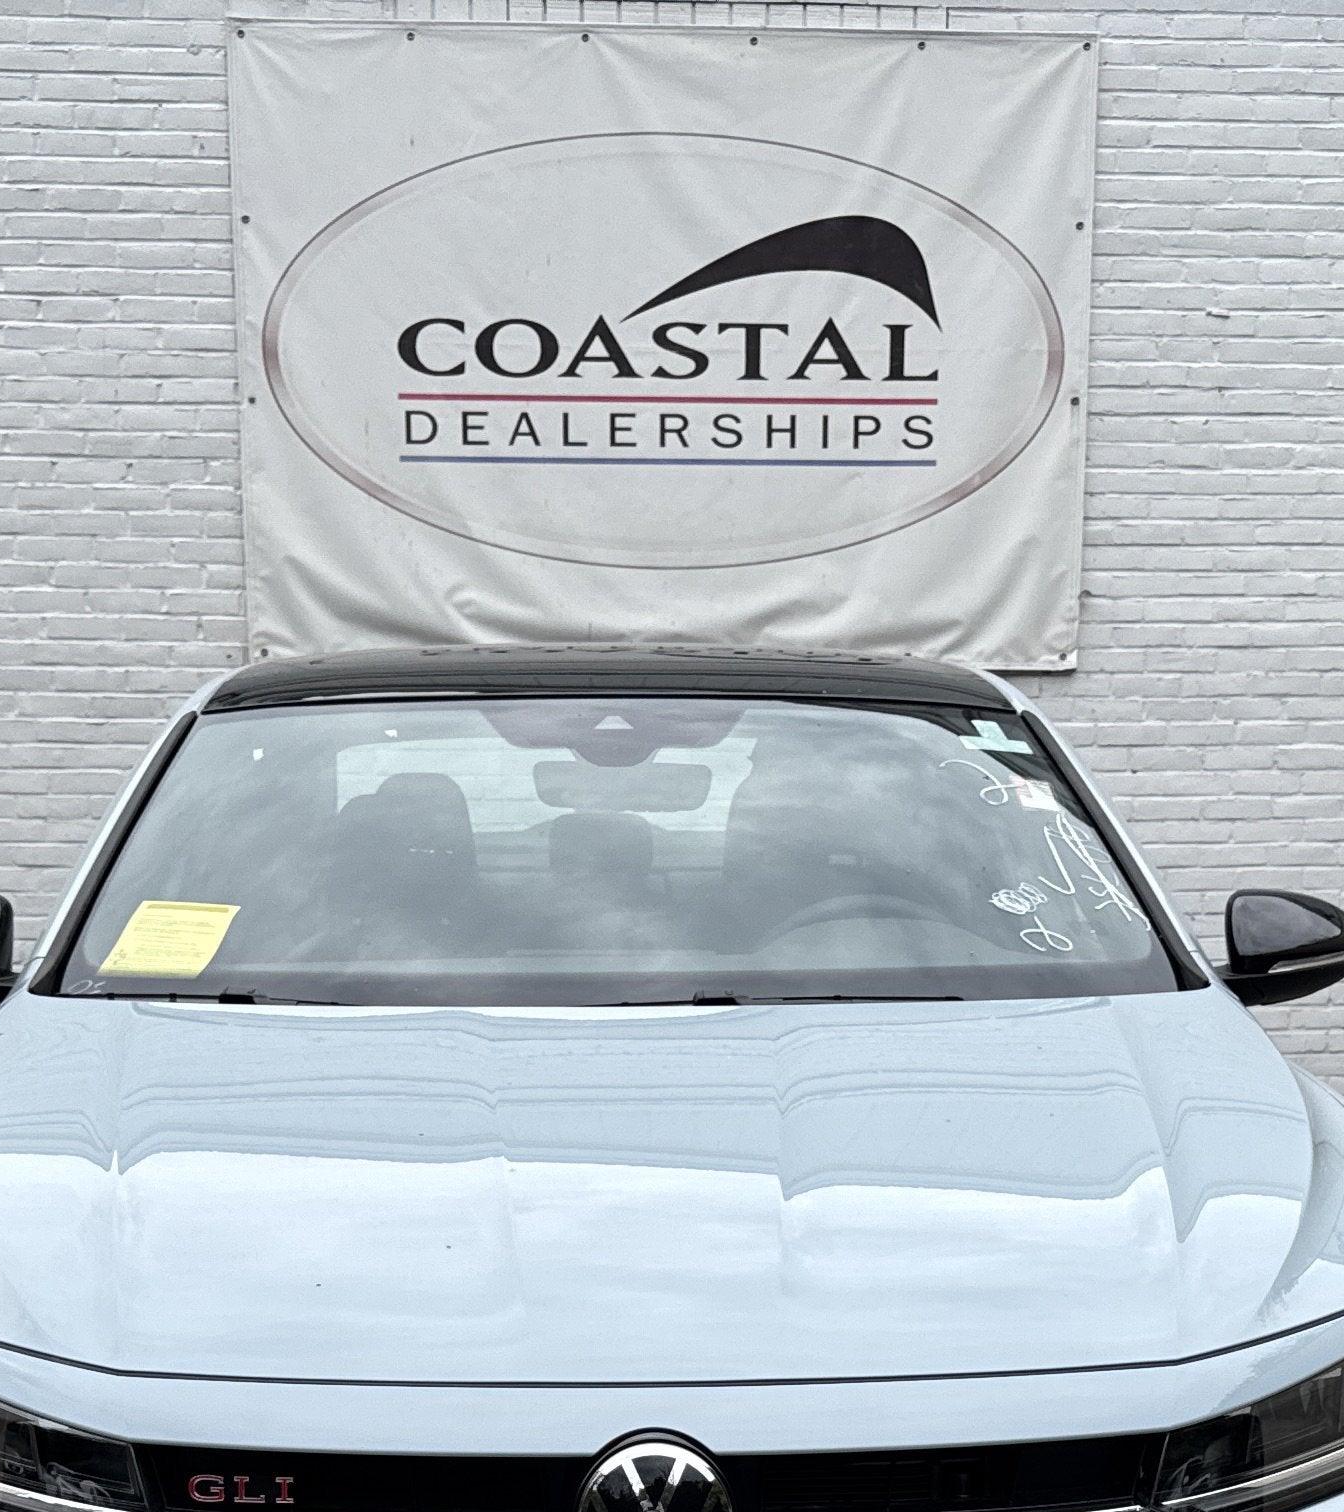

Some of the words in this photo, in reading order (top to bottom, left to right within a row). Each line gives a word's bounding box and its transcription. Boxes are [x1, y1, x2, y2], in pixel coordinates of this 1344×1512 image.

[397, 315, 940, 383] COASTAL
[404, 411, 935, 450] DEALERSHIPS
[188, 1474, 295, 1504] GLI
